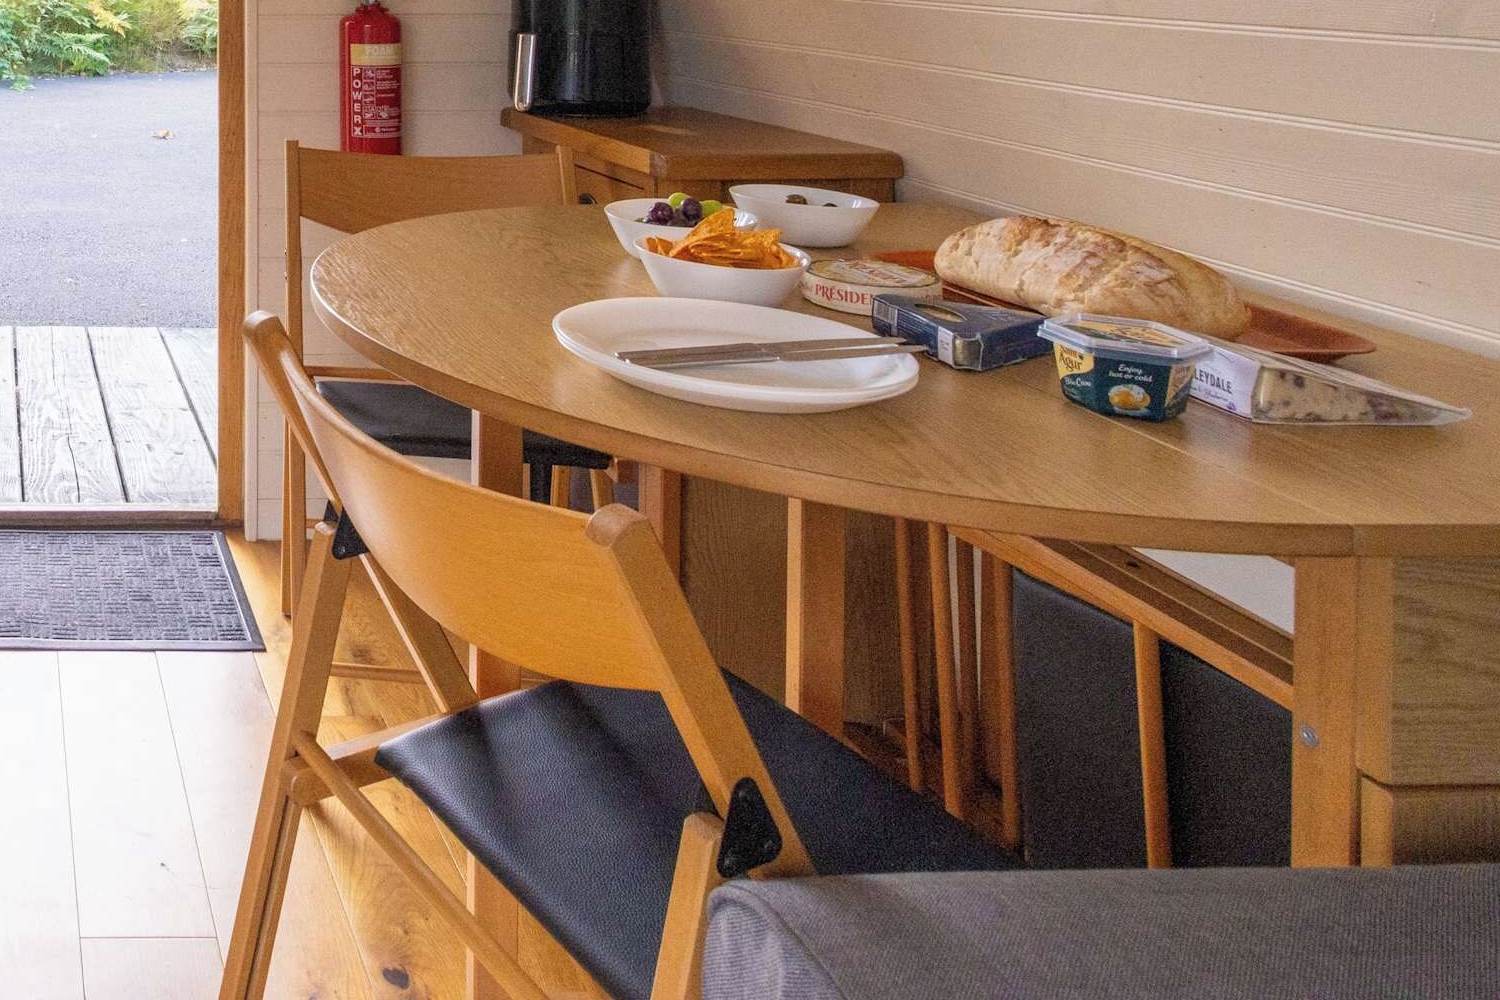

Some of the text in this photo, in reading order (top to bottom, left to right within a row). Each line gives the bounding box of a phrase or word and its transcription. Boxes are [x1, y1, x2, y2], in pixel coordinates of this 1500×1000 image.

[815, 282, 872, 305] PRÉSIDE
[1060, 352, 1082, 372] Agur
[1118, 363, 1143, 374] Enjoy
[1108, 370, 1123, 378] hot
